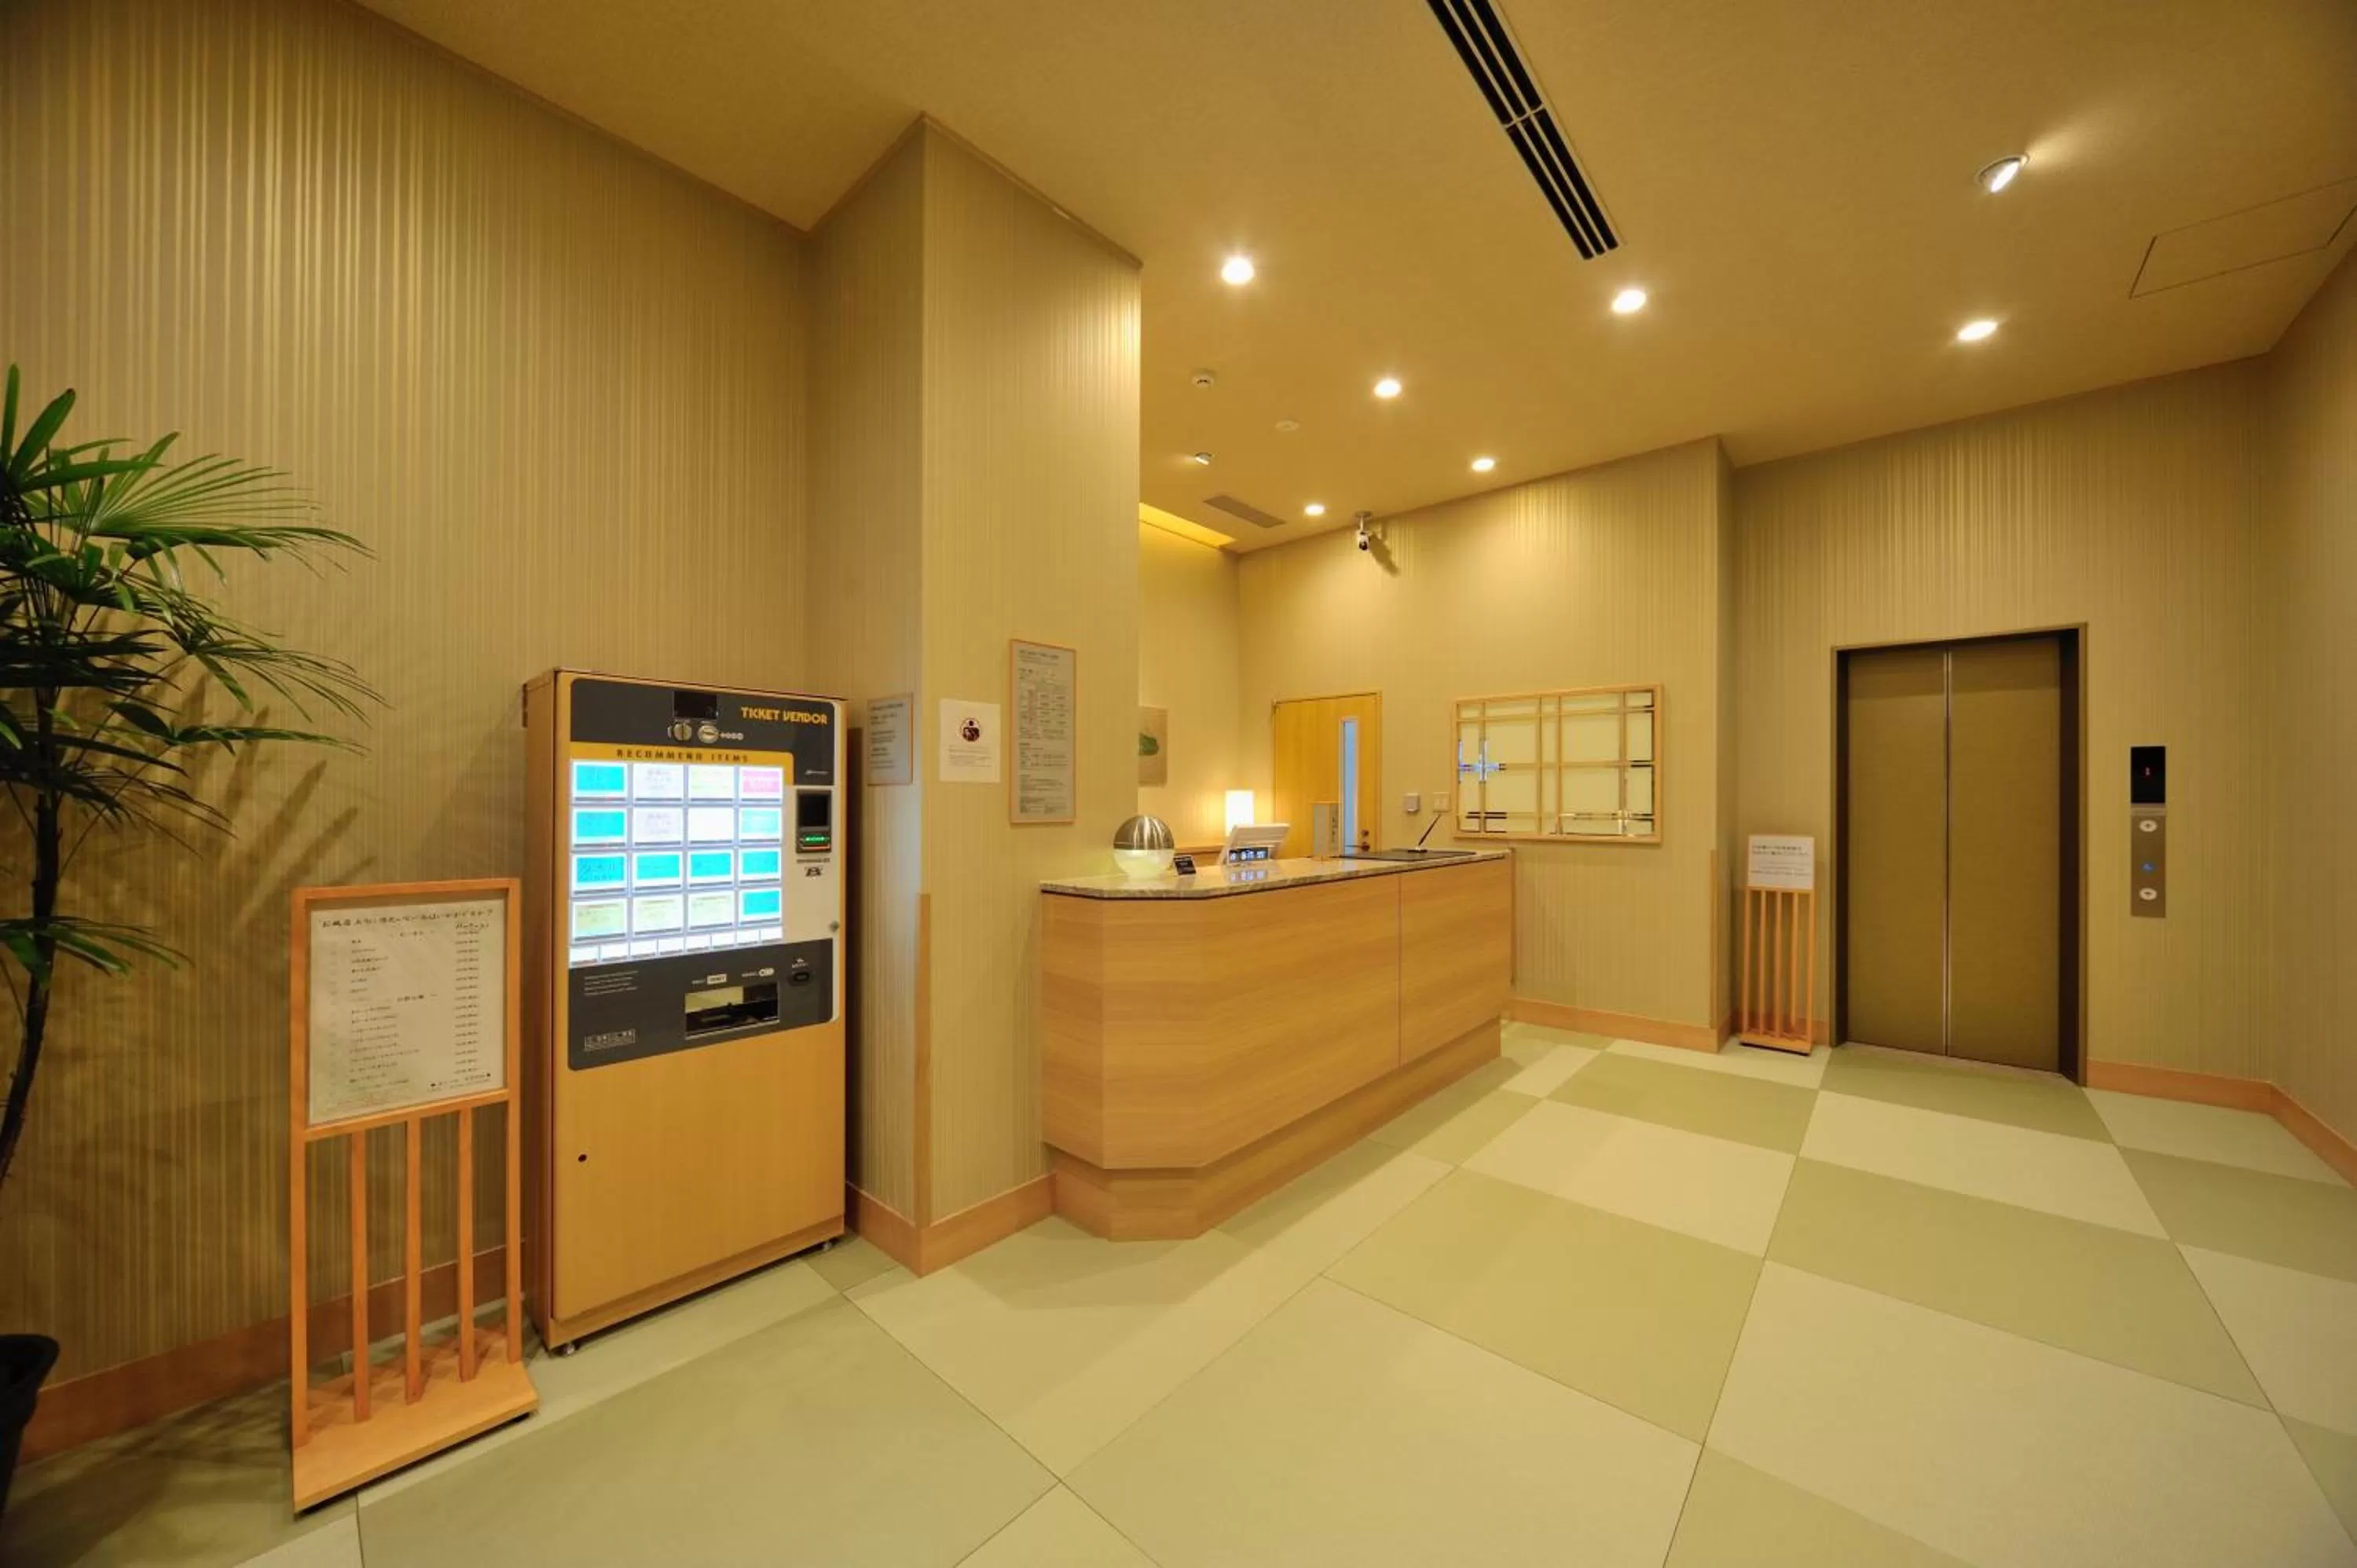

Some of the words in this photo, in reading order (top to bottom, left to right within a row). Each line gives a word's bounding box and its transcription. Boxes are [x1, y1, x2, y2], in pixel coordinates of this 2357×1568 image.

[741, 706, 780, 721] TICKET
[783, 710, 827, 725] VENDOR
[617, 749, 702, 761] RECOMMEND
[711, 753, 749, 763] ITEMS
